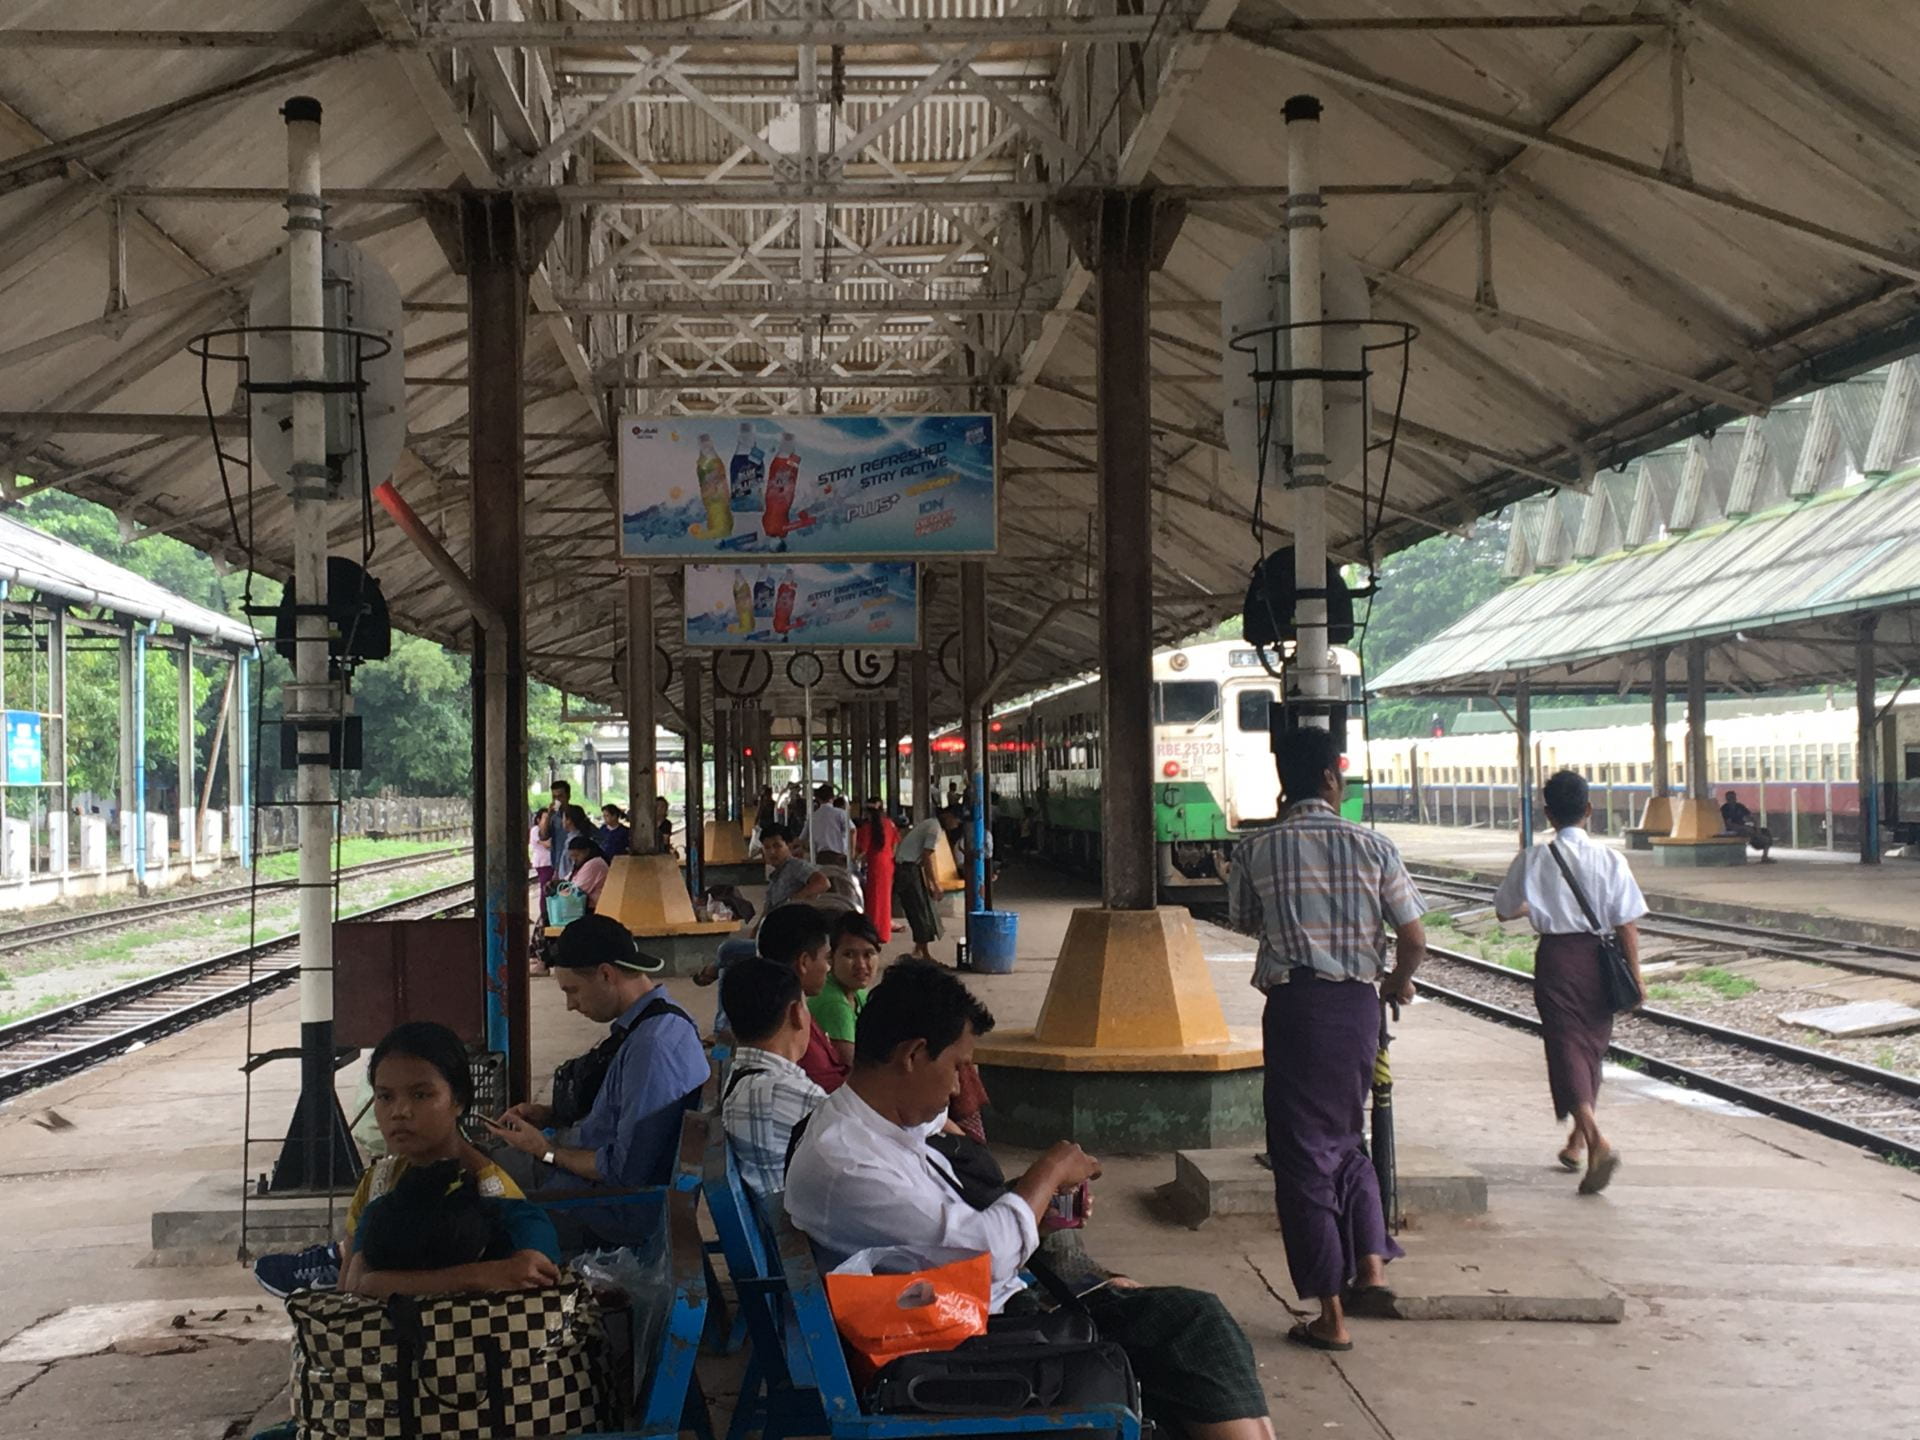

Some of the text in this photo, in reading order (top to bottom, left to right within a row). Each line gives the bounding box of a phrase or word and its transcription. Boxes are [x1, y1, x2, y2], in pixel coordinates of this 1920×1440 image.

[817, 465, 857, 486] STAY
[860, 441, 947, 474] REFRESHED
[860, 470, 901, 489] STAY
[900, 455, 949, 478] ACTIVE
[730, 649, 756, 688] 7
[730, 698, 762, 711] WEST
